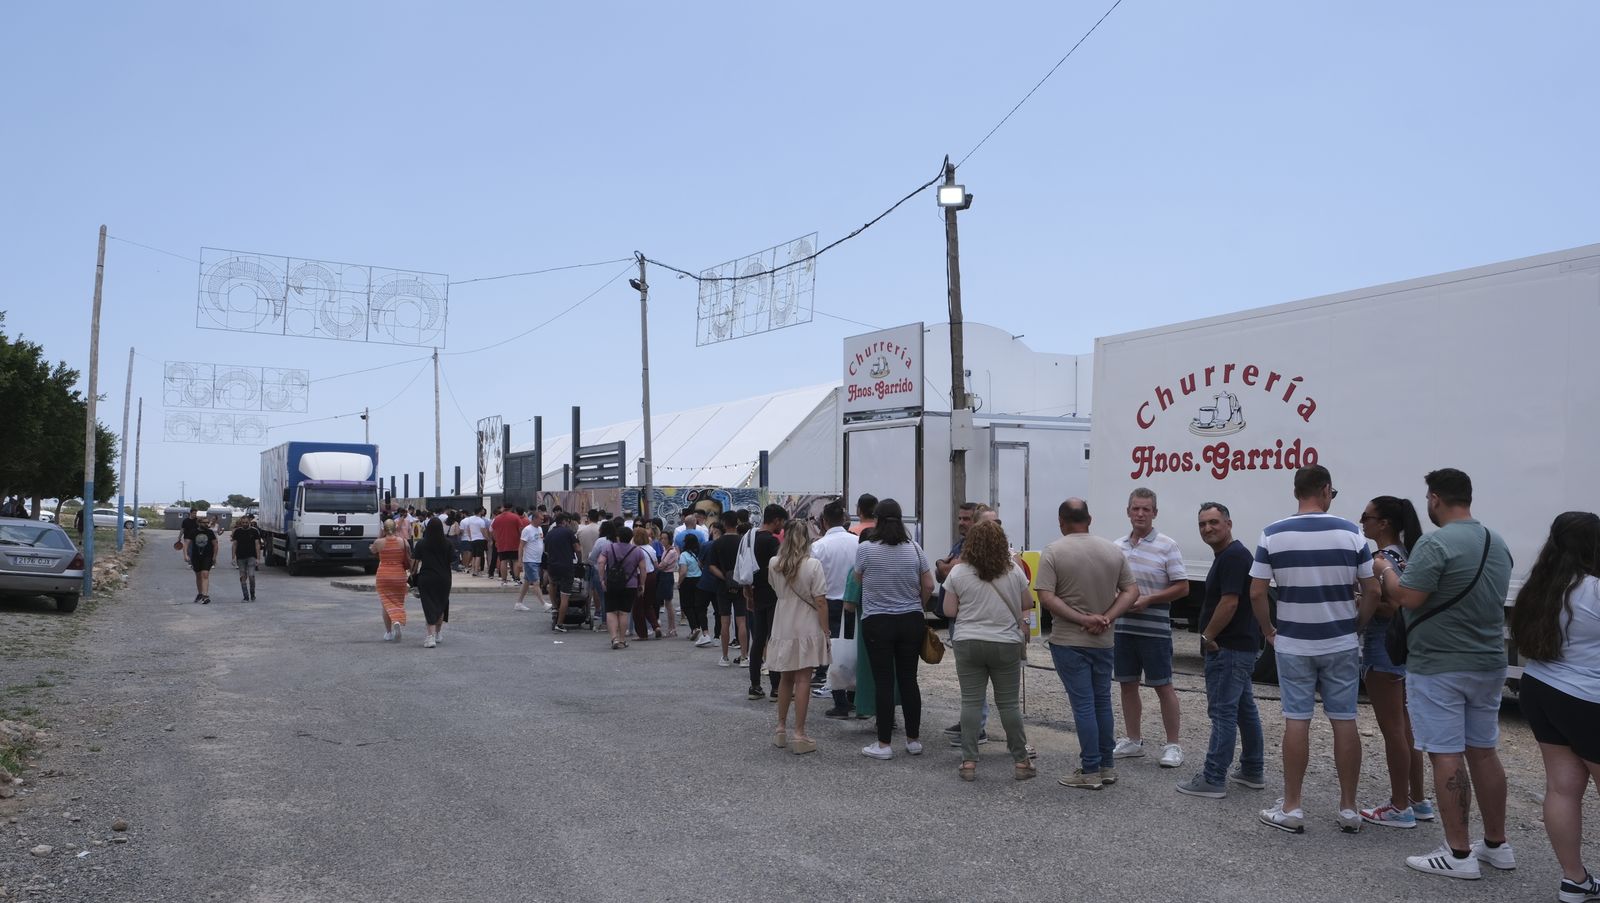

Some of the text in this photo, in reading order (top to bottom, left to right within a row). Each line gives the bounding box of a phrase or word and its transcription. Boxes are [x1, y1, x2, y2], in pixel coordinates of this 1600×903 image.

[847, 378, 913, 402] Hnos. Garrido
[1136, 363, 1317, 430] Churrería
[1130, 438, 1319, 480] Hnos. Garrido
